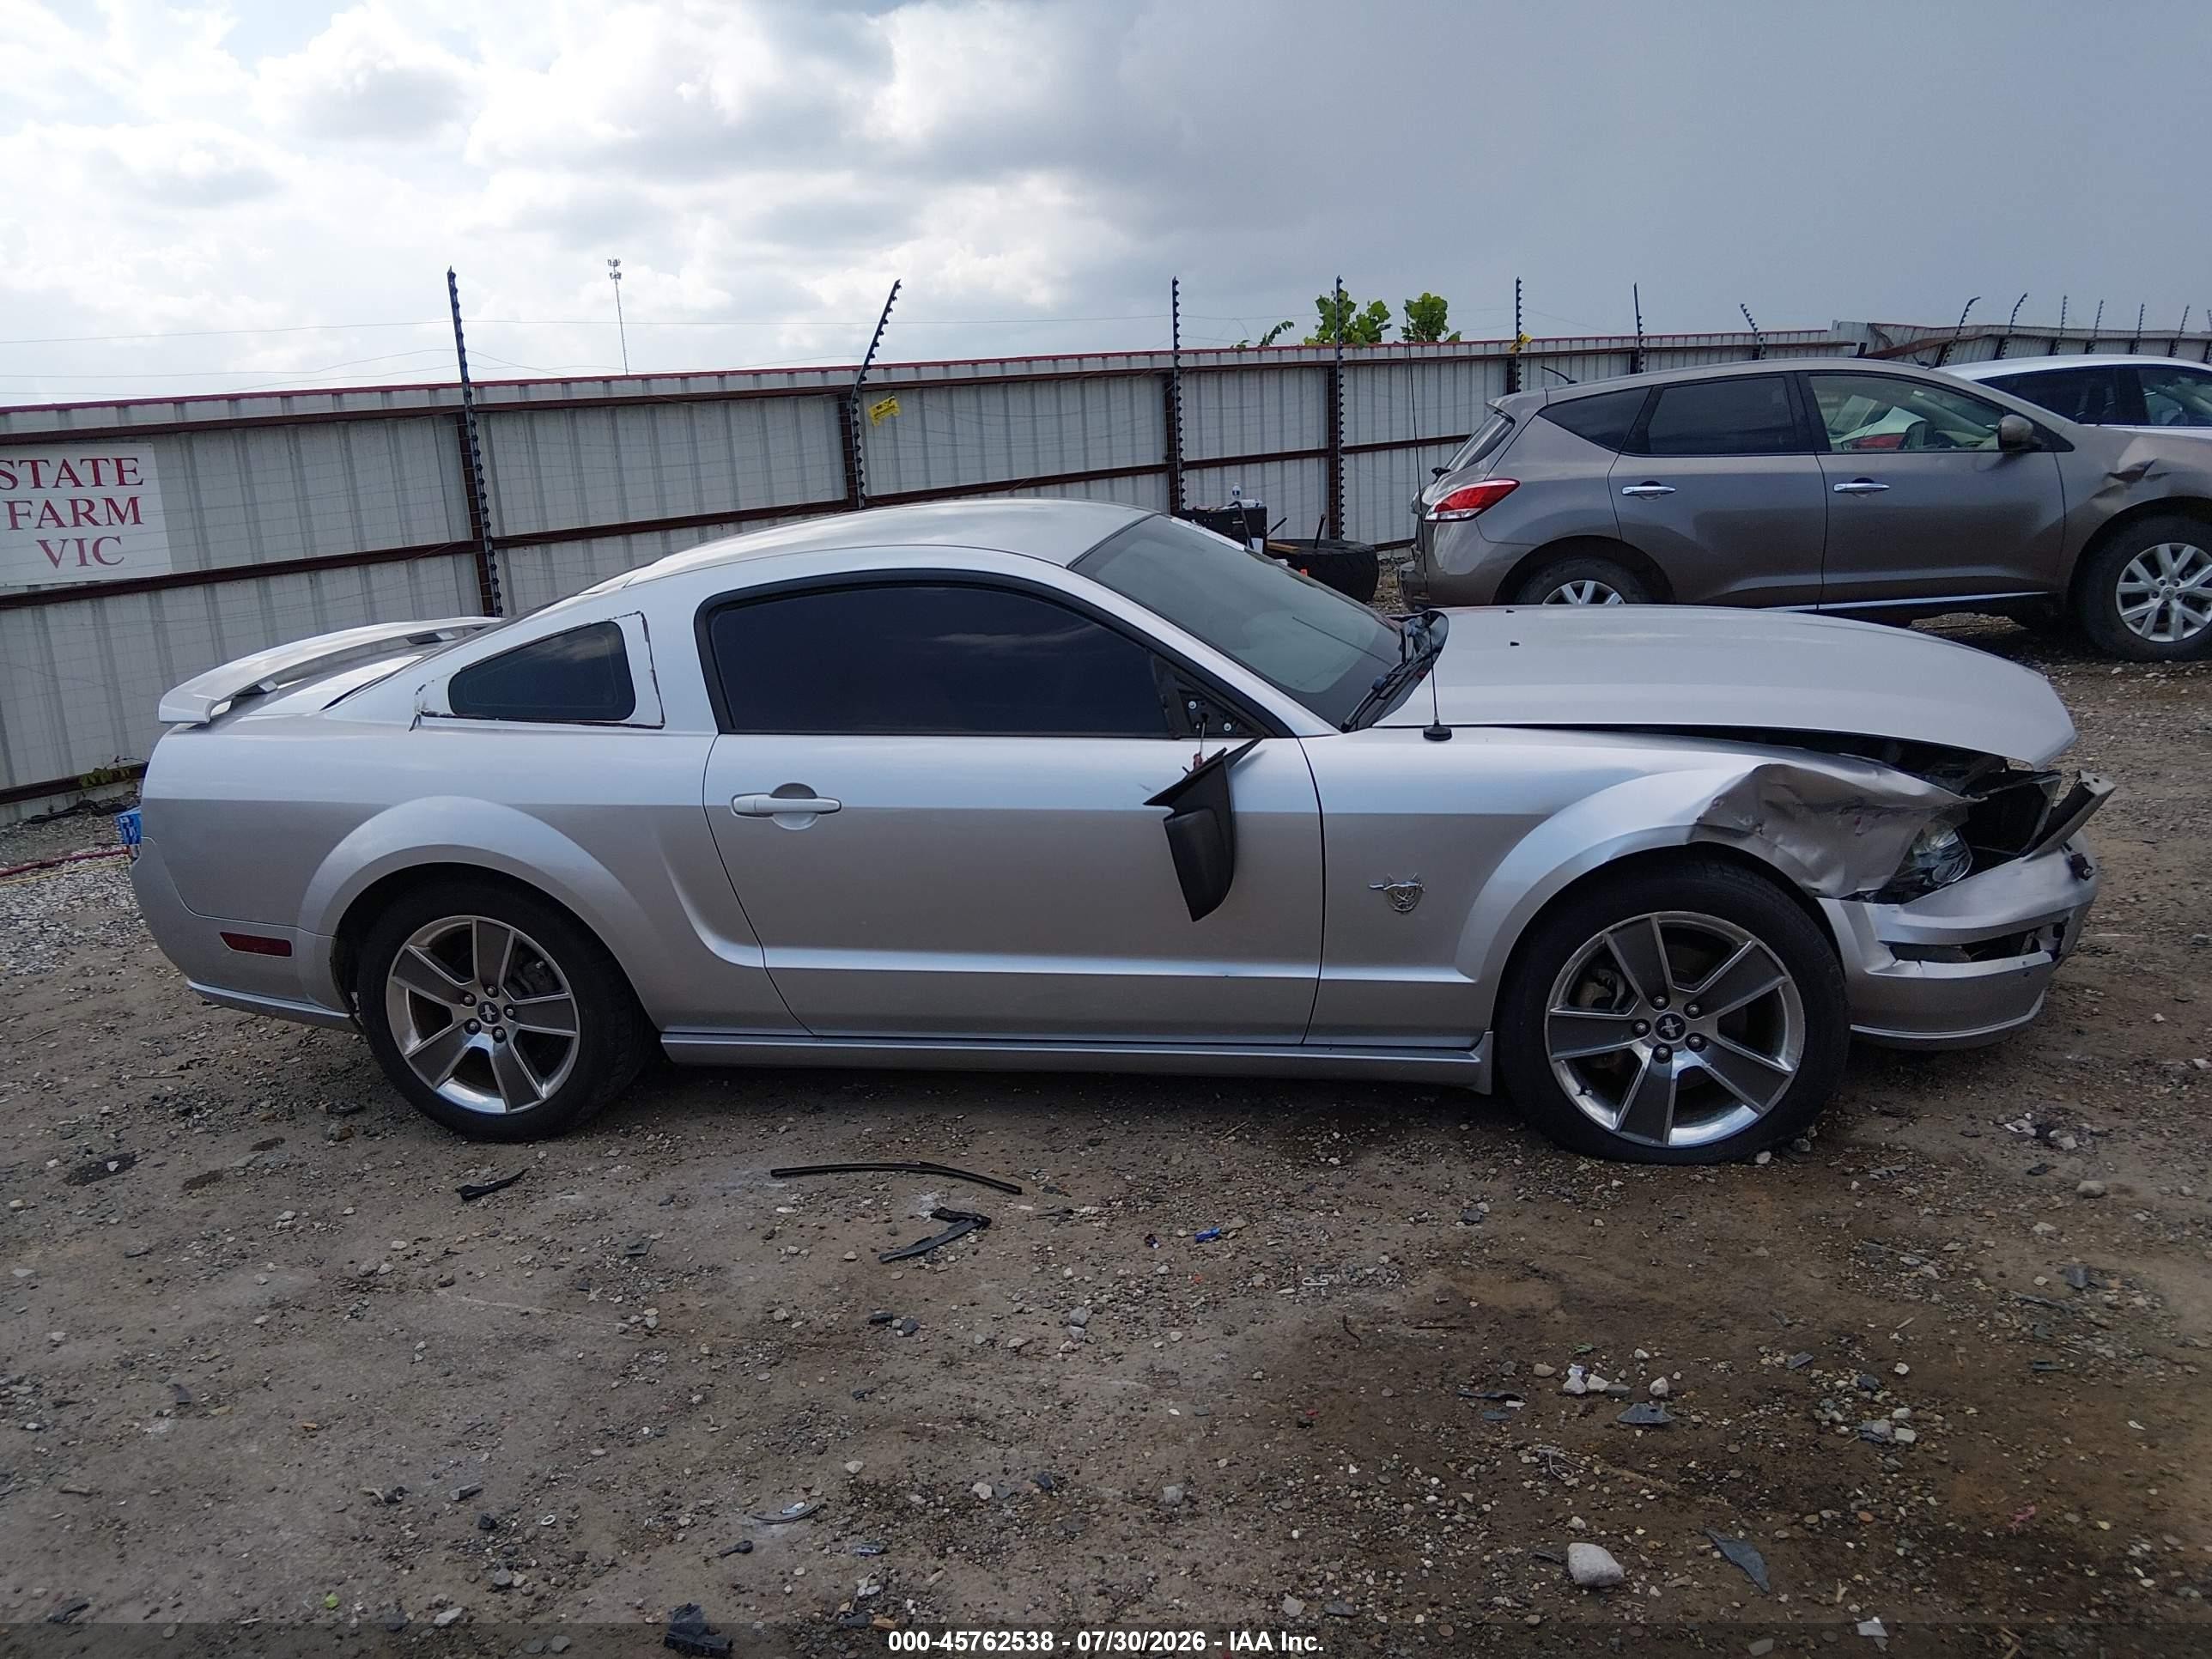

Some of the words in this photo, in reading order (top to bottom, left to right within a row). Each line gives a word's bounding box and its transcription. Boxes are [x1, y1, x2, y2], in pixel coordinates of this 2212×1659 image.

[0, 457, 144, 490] STATE
[3, 495, 145, 531] FARM
[35, 535, 125, 569] VIC
